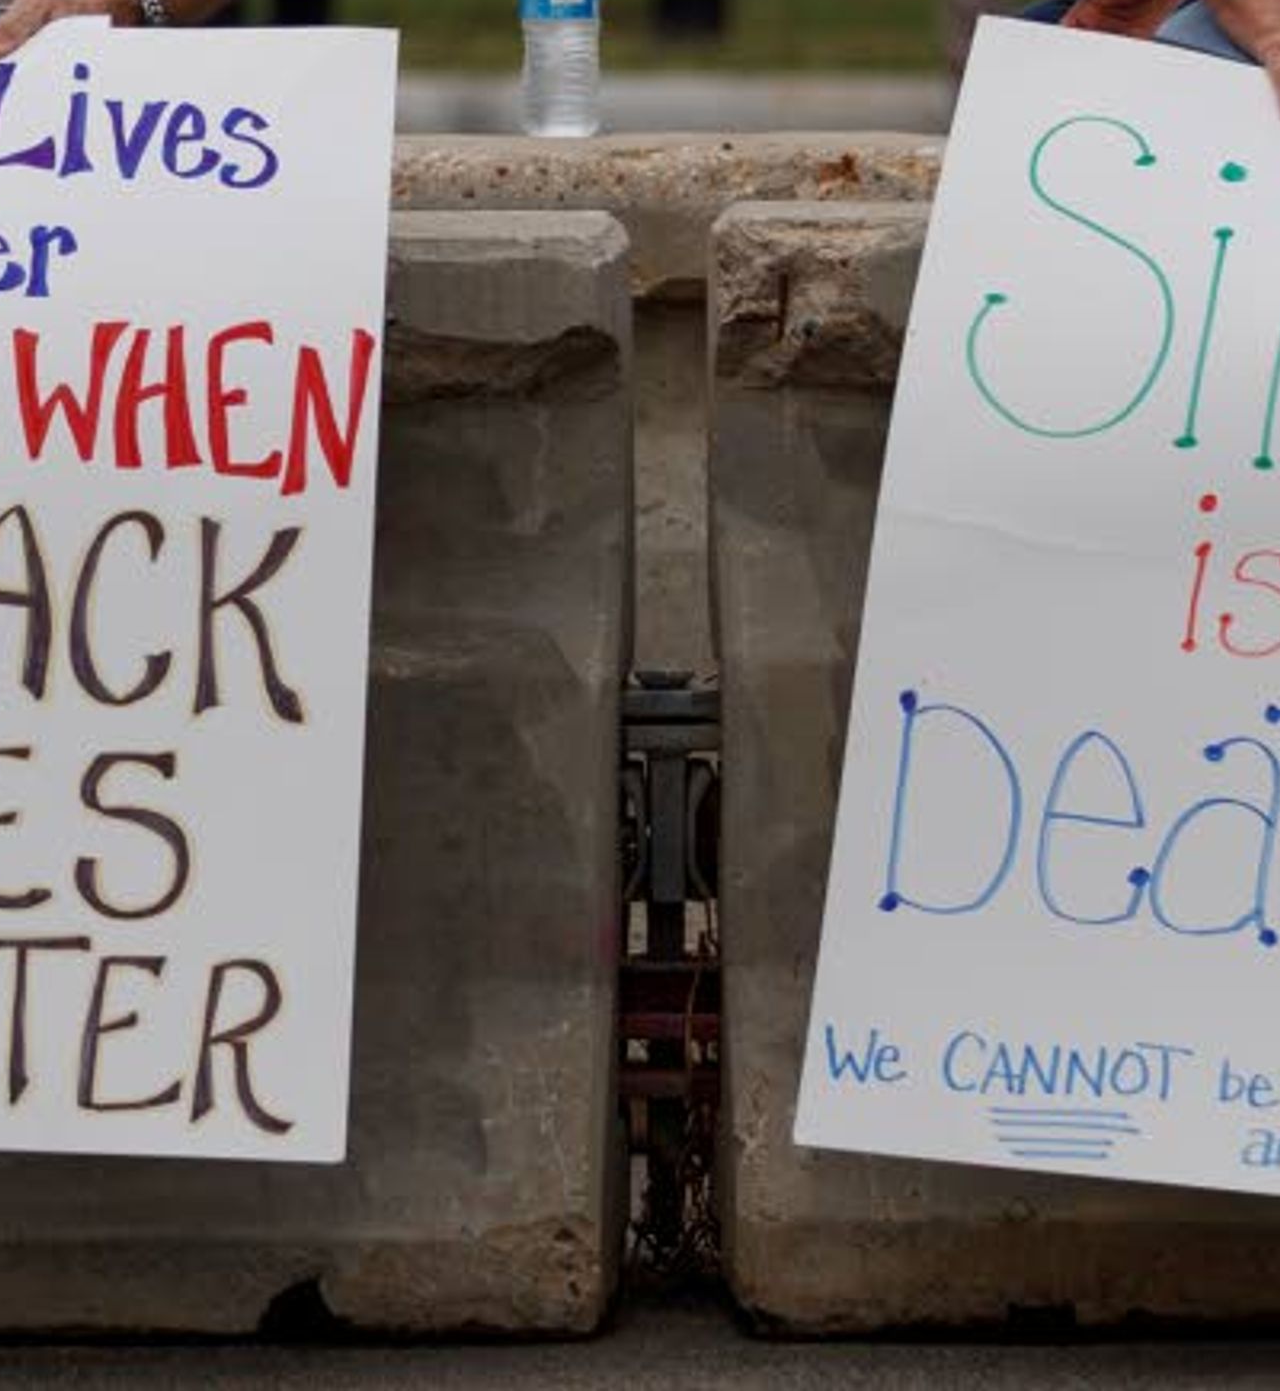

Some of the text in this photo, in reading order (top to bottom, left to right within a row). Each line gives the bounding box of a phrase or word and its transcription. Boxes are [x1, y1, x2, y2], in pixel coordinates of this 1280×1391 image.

[12, 320, 376, 496] WHEN
[824, 1024, 908, 1084] We
[941, 1031, 1194, 1101] CANNOT
[1218, 1060, 1280, 1109] be
